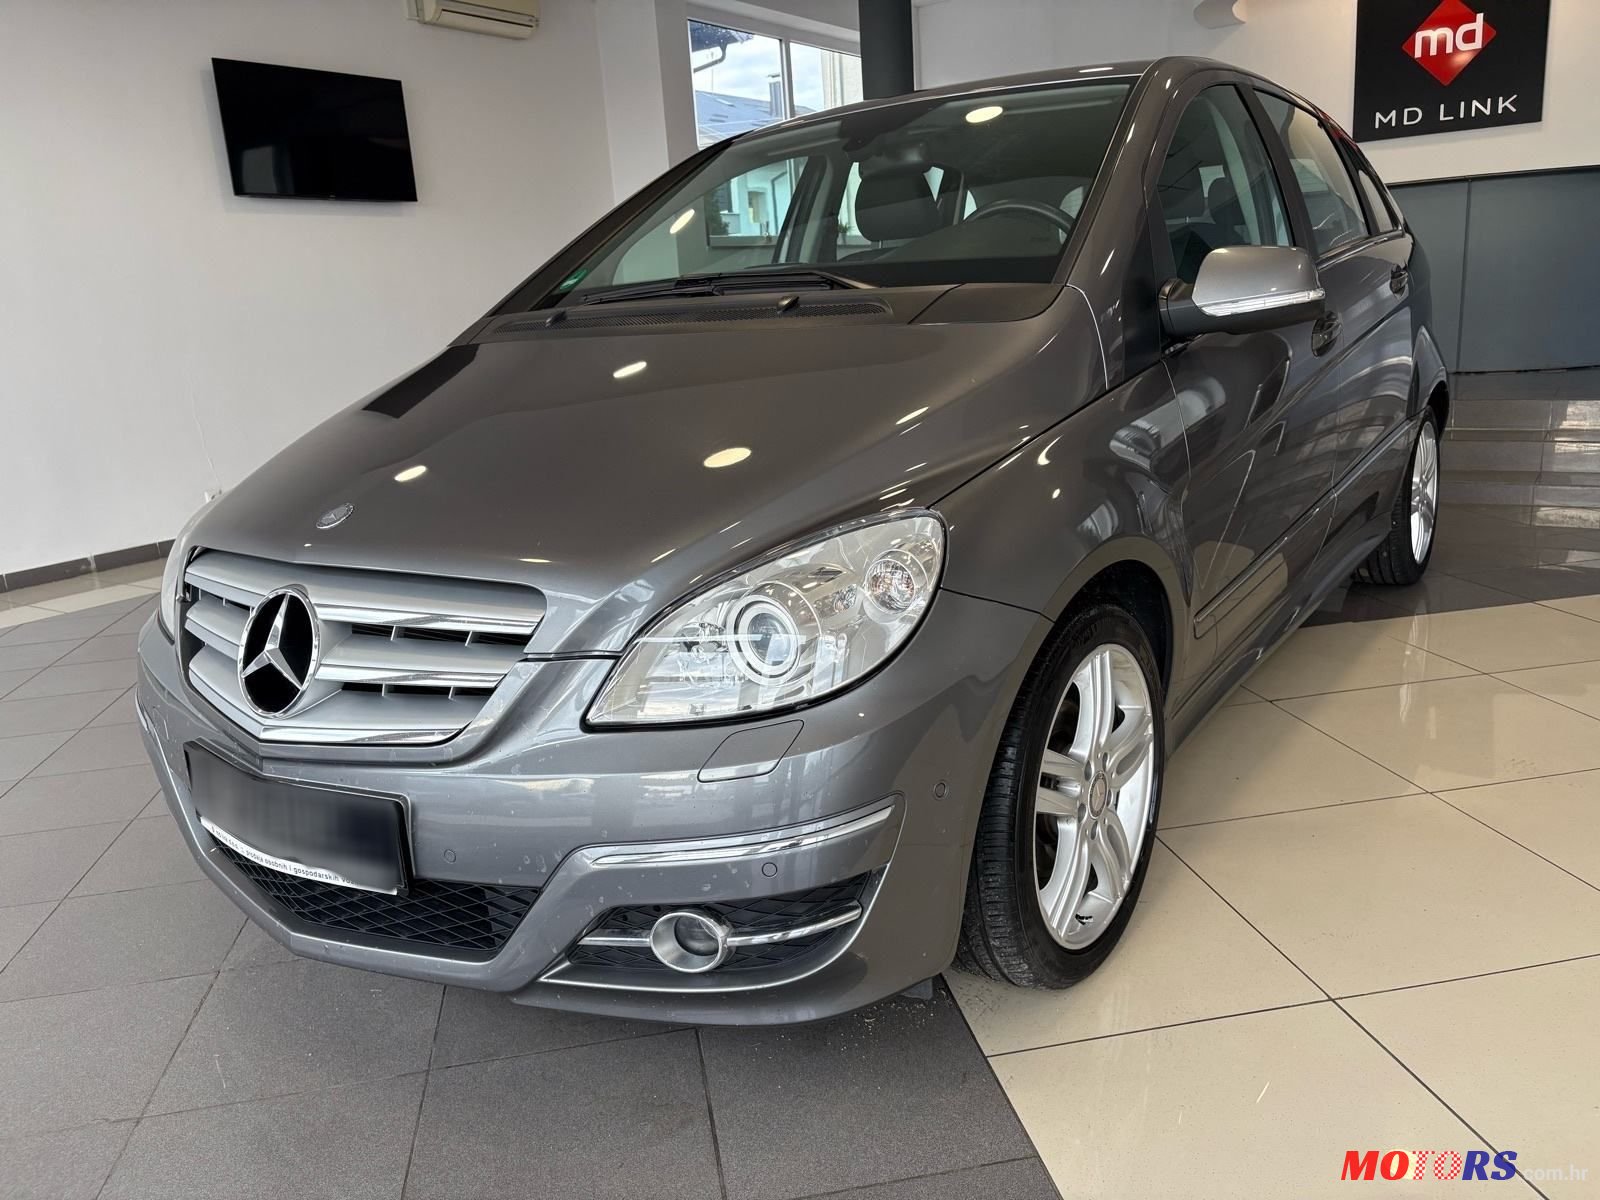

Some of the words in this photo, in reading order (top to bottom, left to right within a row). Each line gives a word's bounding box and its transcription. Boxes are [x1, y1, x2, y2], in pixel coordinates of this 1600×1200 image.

[1414, 12, 1484, 58] md
[1375, 107, 1423, 129] MD
[1440, 94, 1518, 121] LINK
[293, 866, 339, 881] gospodarskih
